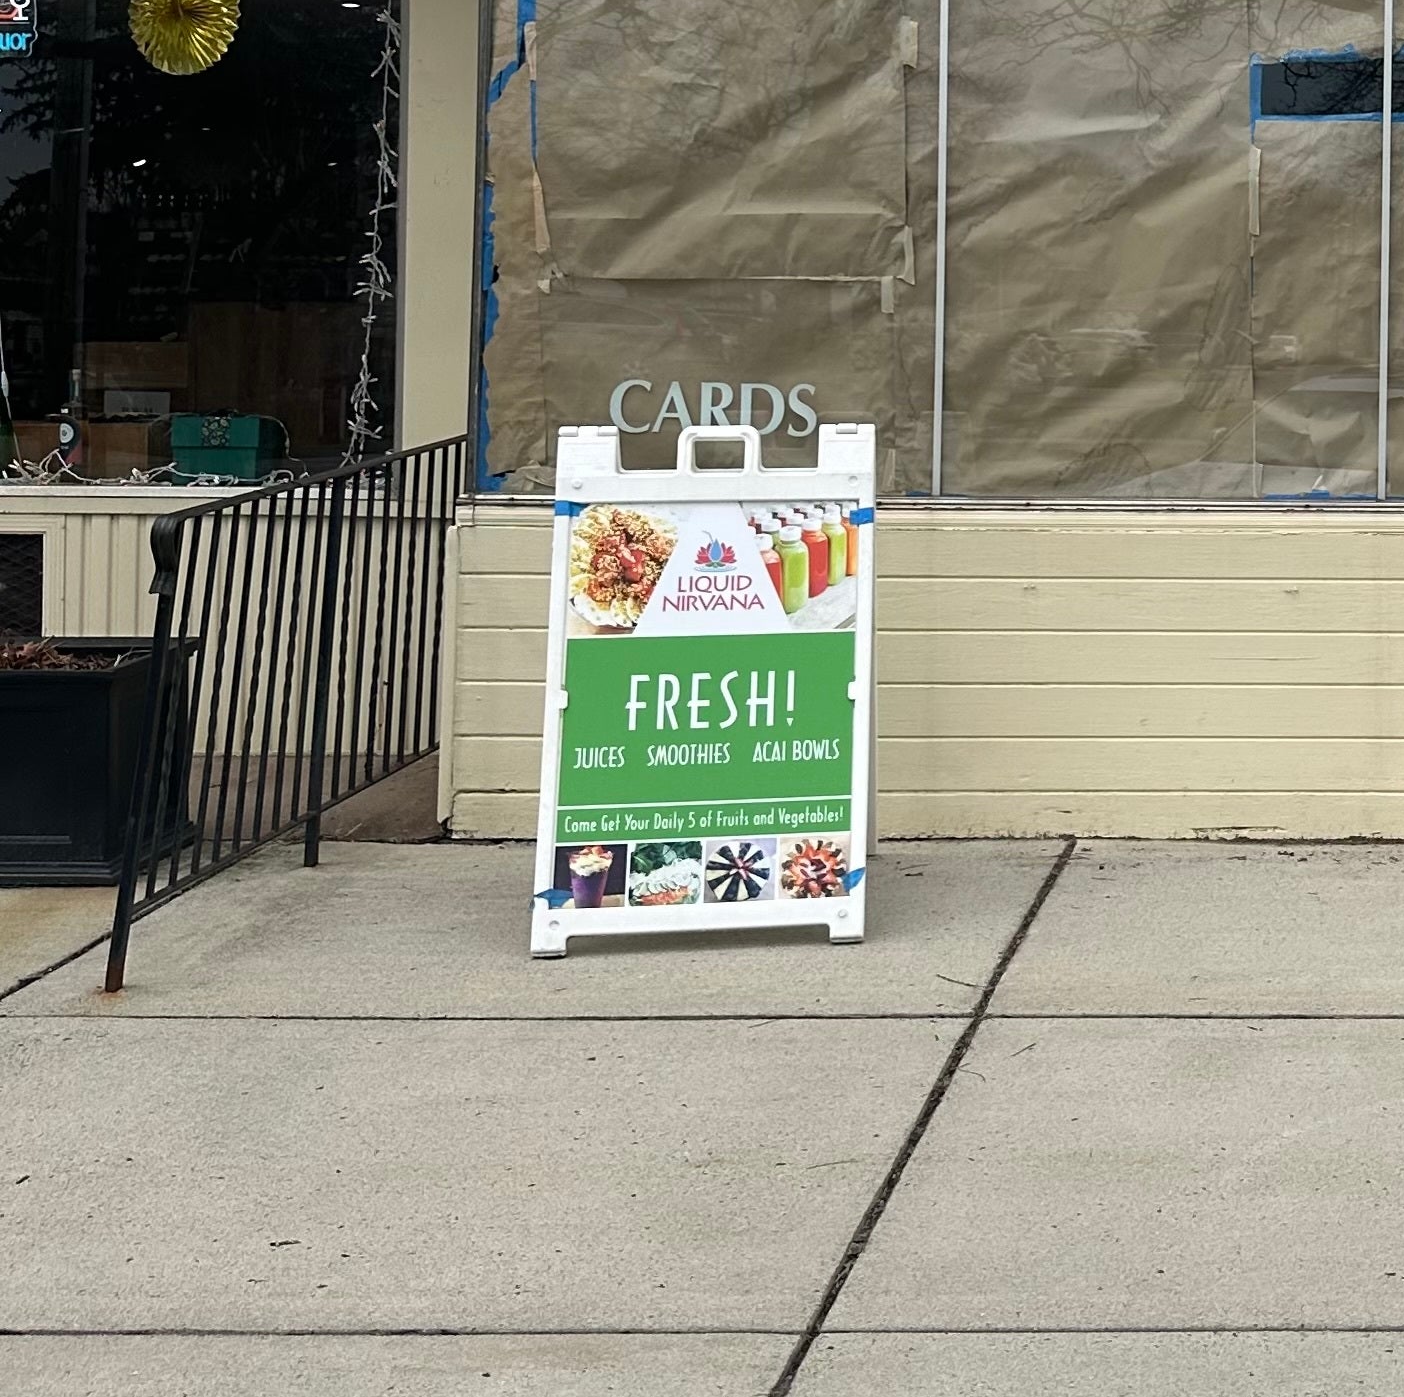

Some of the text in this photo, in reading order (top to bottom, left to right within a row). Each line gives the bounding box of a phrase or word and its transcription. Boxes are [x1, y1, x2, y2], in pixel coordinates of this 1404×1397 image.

[609, 379, 818, 437] CARDS
[677, 575, 752, 593] LIQUID
[662, 593, 765, 612] NIRVANA
[625, 670, 795, 731] FRESH!
[573, 738, 840, 769] JUICES SMOOTHIES ACAI BOWLS
[564, 805, 844, 833] Come Get Your Daily 5 of Fruits and Vegetables!
